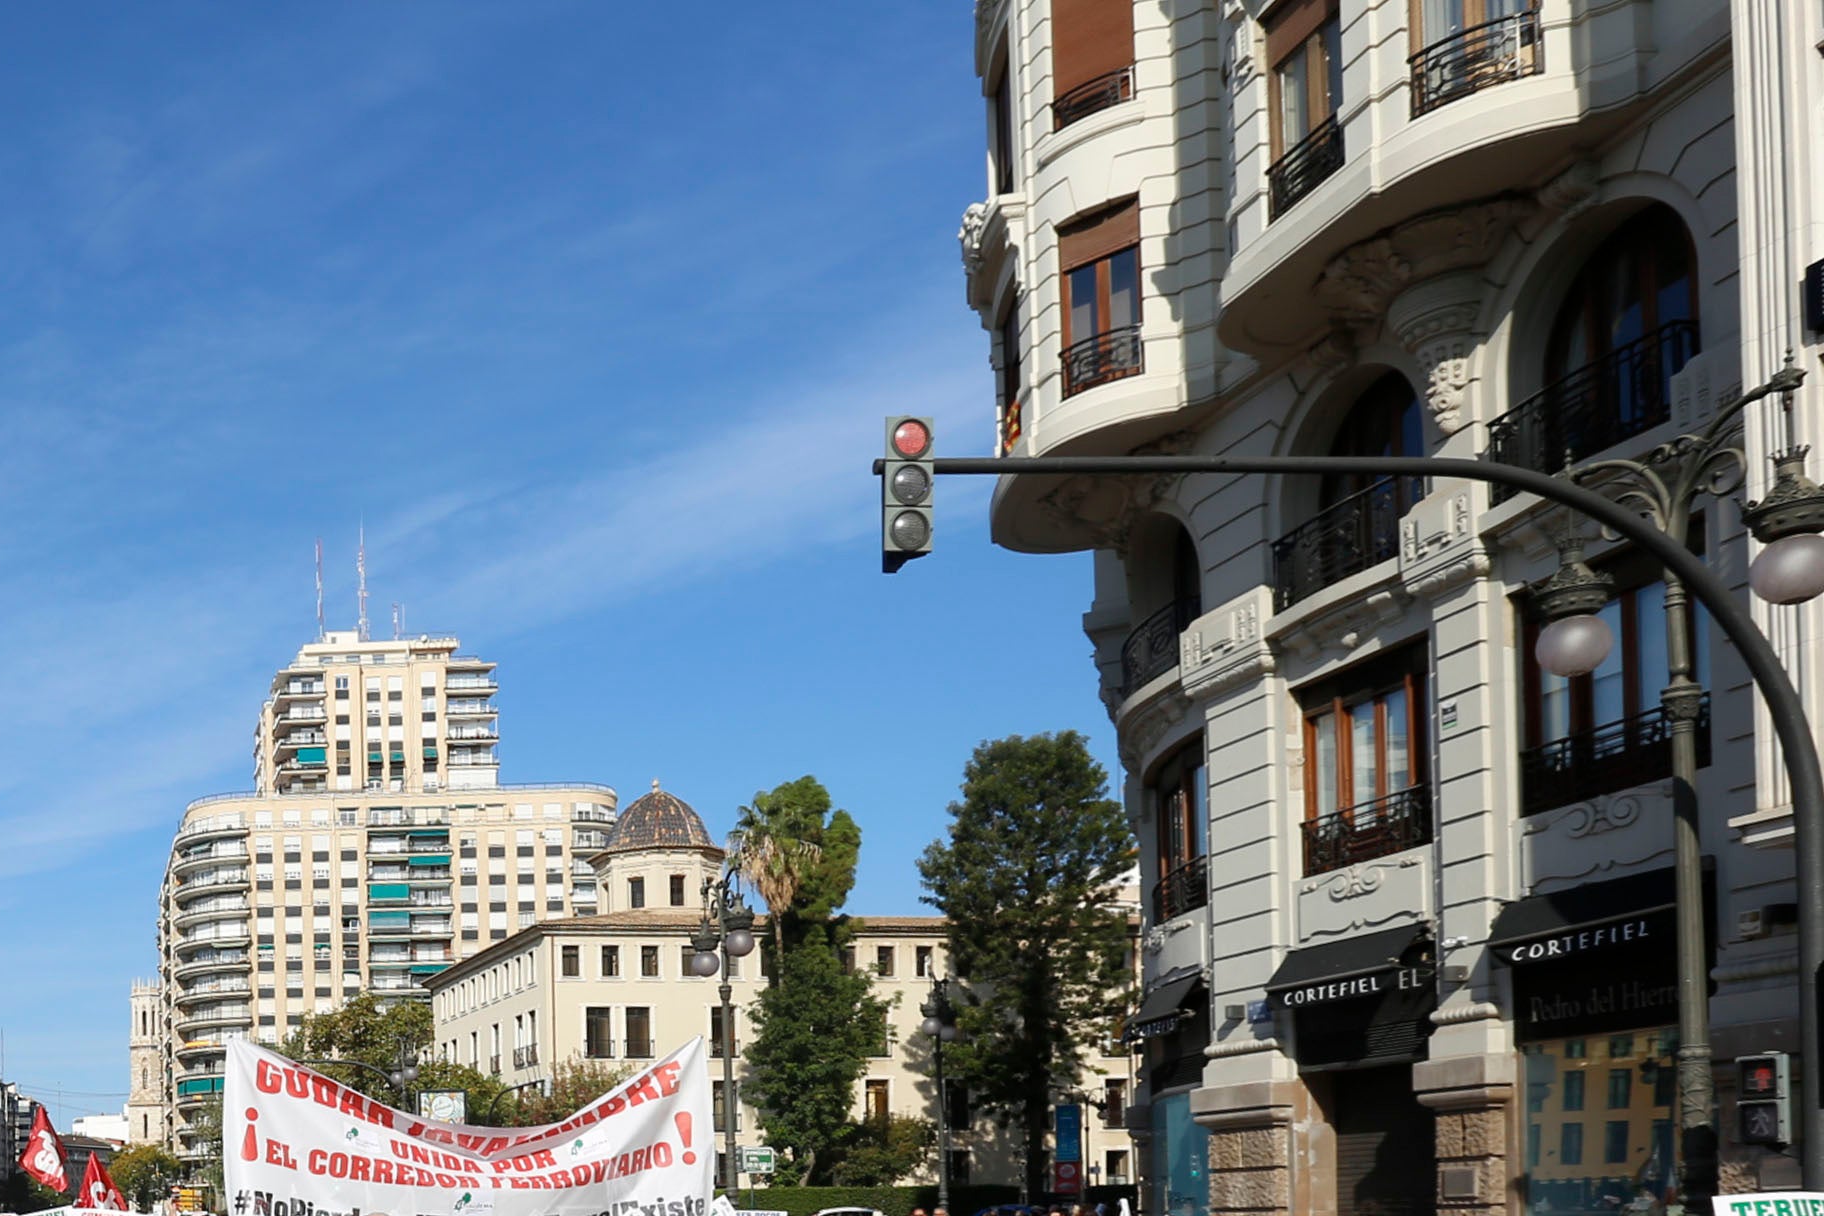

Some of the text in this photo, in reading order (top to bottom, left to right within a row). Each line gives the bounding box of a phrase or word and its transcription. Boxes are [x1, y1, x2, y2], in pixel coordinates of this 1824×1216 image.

[1511, 921, 1649, 961] CORTEFIEL
[1284, 977, 1380, 1006] CORTEFIEL
[1586, 985, 1614, 1015] del
[1621, 981, 1678, 1011] Hierr
[308, 1150, 480, 1188] CORREDOR
[391, 1139, 557, 1174] UNIDA POR
